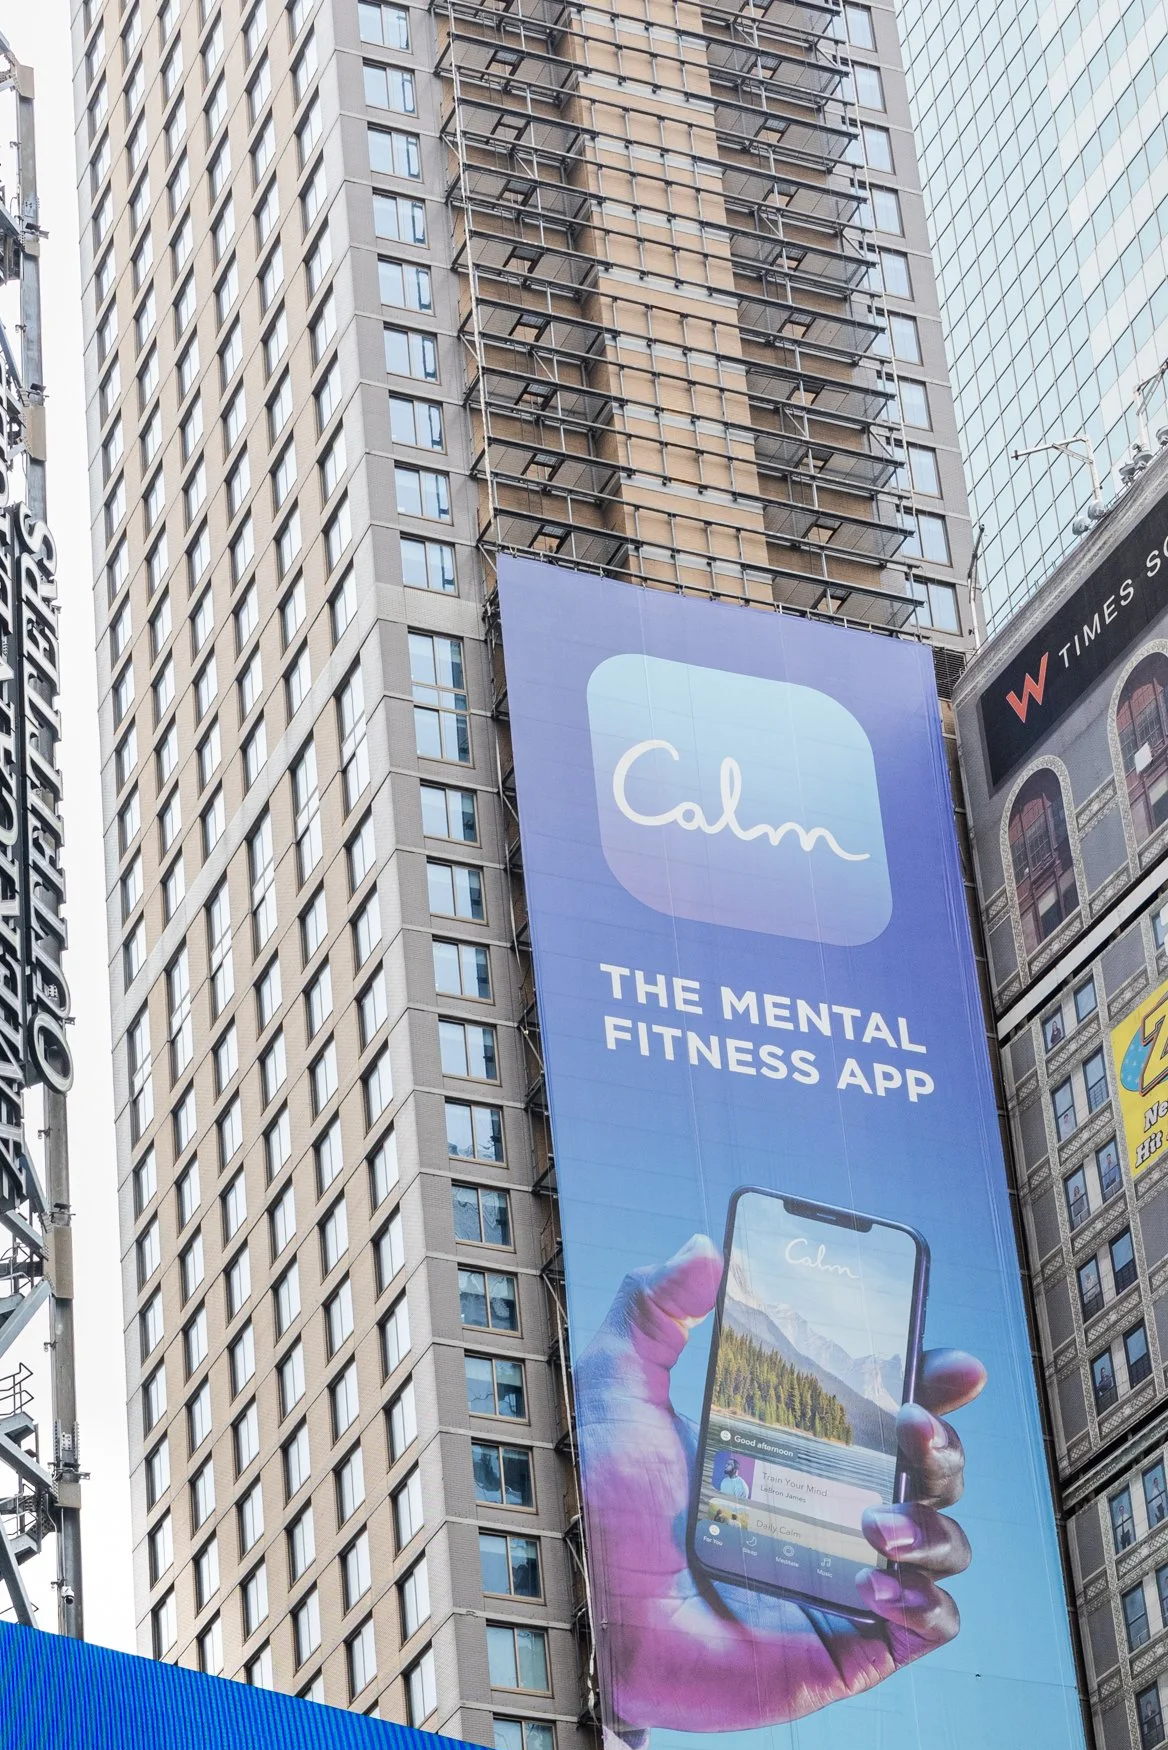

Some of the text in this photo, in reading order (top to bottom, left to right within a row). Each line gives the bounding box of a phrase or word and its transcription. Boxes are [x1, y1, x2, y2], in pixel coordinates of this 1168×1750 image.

[1058, 577, 1134, 669] TIMES
[612, 739, 871, 861] Calm
[599, 963, 927, 1055] THE MENTAL
[603, 1015, 936, 1102] FITNESS APP
[1136, 1129, 1163, 1168] Hit
[785, 1238, 860, 1279] Calm
[734, 1434, 794, 1458] Good afternoon
[762, 1471, 828, 1498] Train Your Mind
[756, 1519, 802, 1540] Daily Calm
